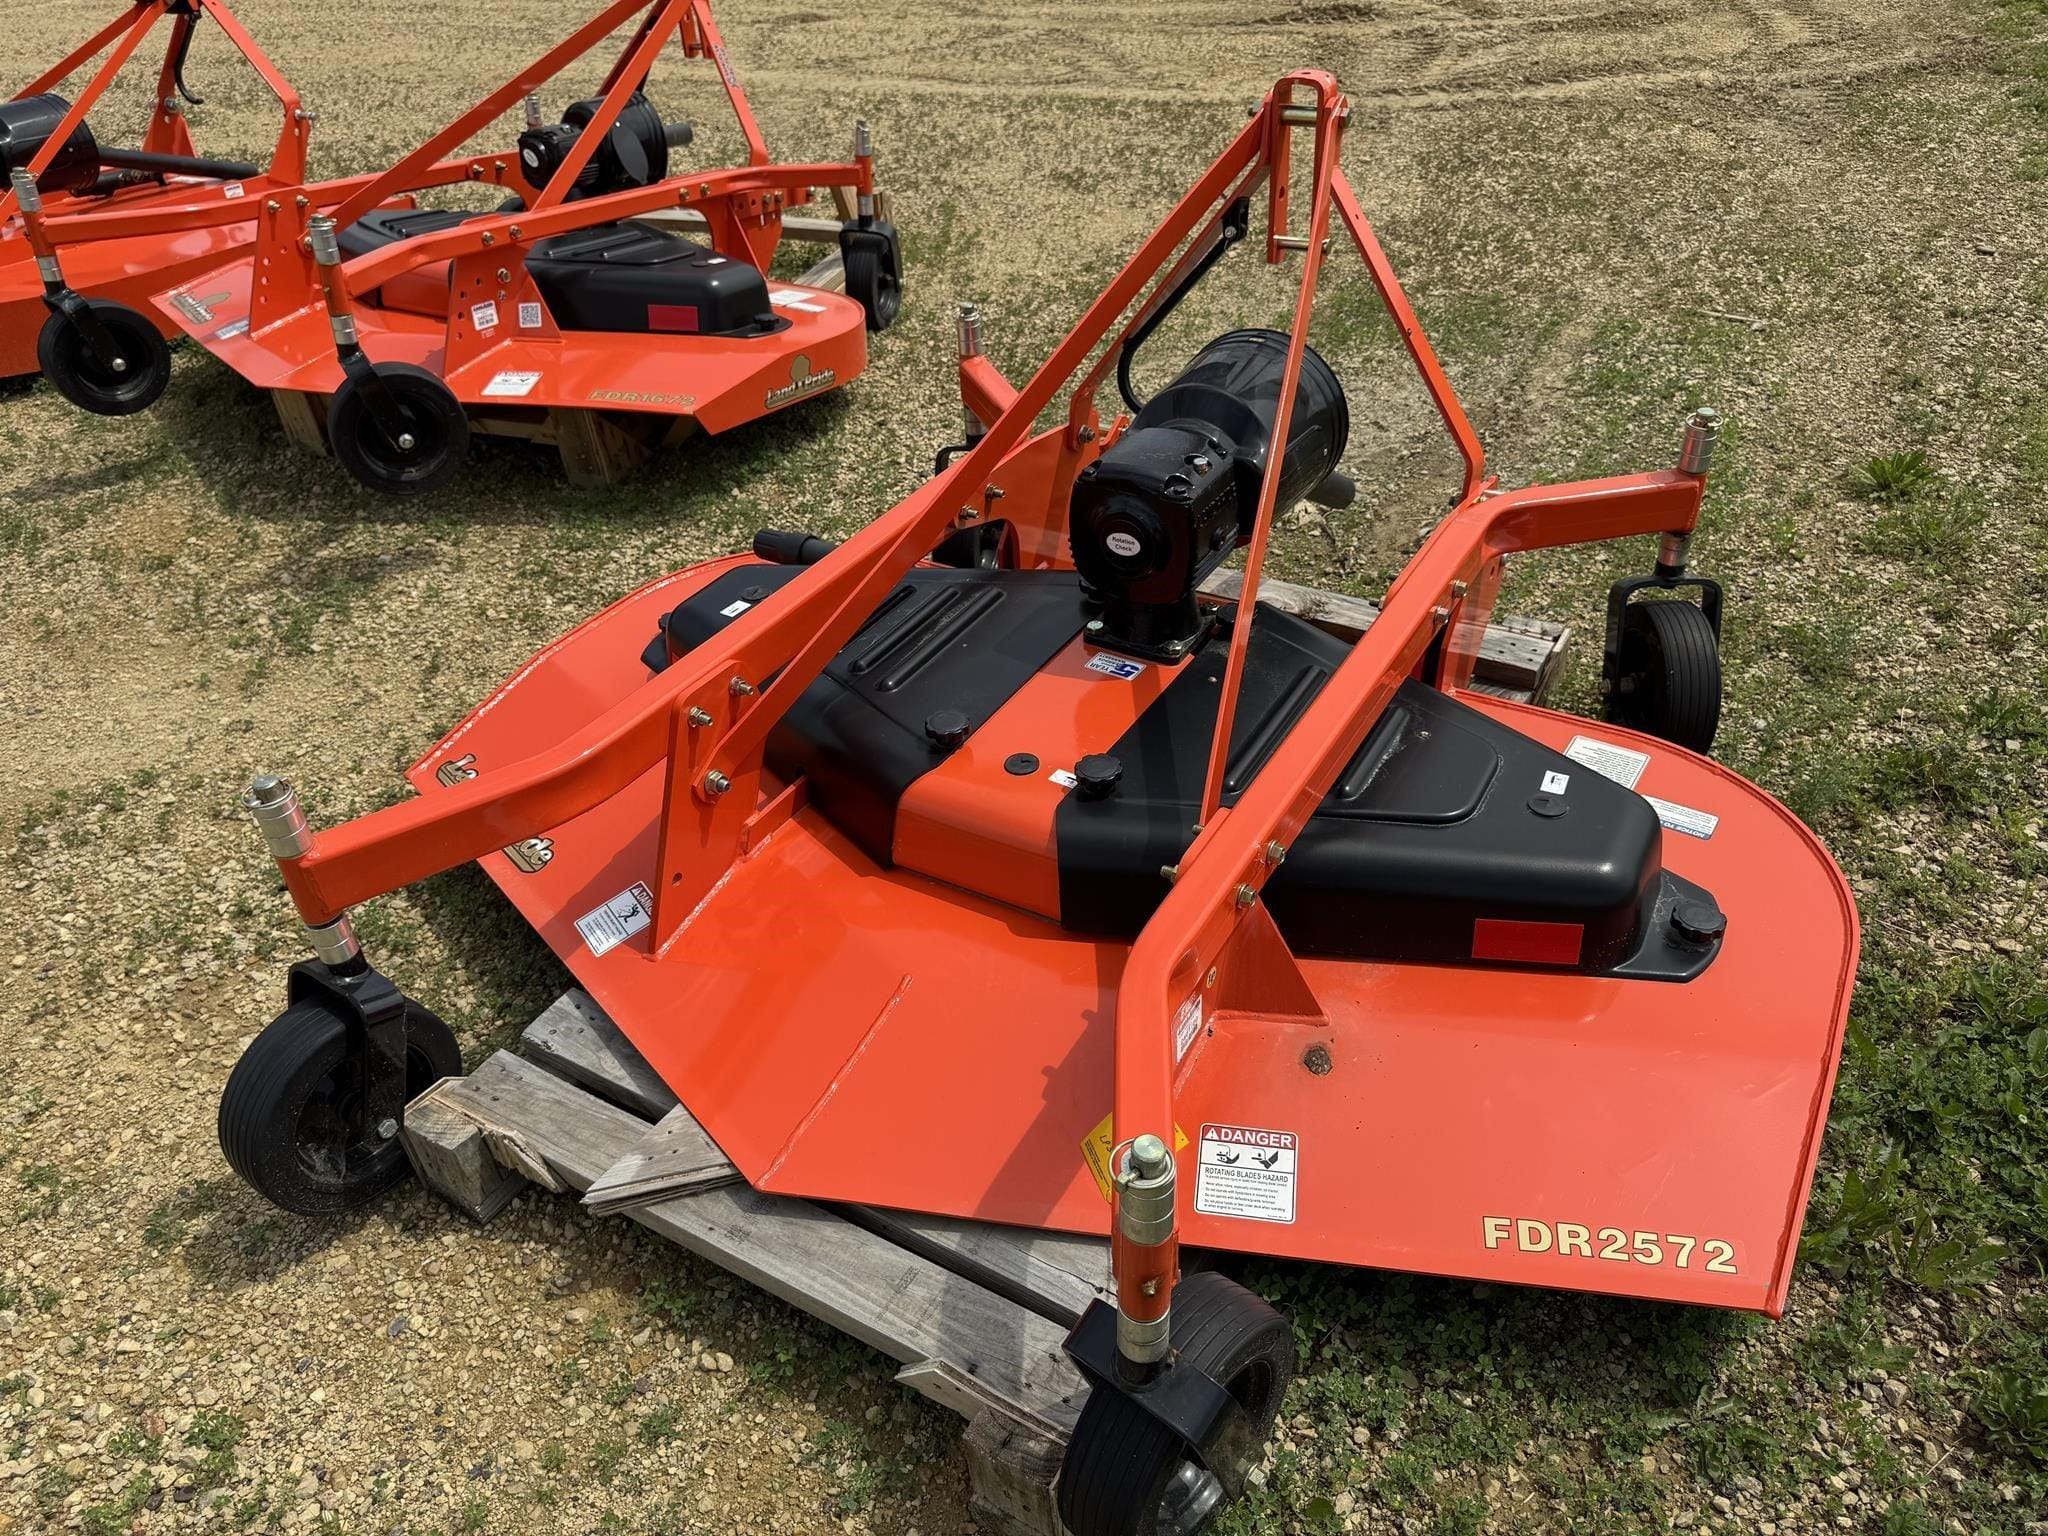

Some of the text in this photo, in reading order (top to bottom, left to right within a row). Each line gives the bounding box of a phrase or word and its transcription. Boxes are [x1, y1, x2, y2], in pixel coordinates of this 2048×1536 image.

[767, 369, 835, 400] Land Pride
[589, 389, 696, 406] FDR1672
[1111, 536, 1135, 546] Rotation
[1221, 1128, 1292, 1148] DANGER
[1204, 1167, 1235, 1177] ROTATING
[1236, 1170, 1261, 1180] BLADES
[1262, 1174, 1289, 1183] HAZARD
[1482, 1216, 1738, 1274] FDR2572
